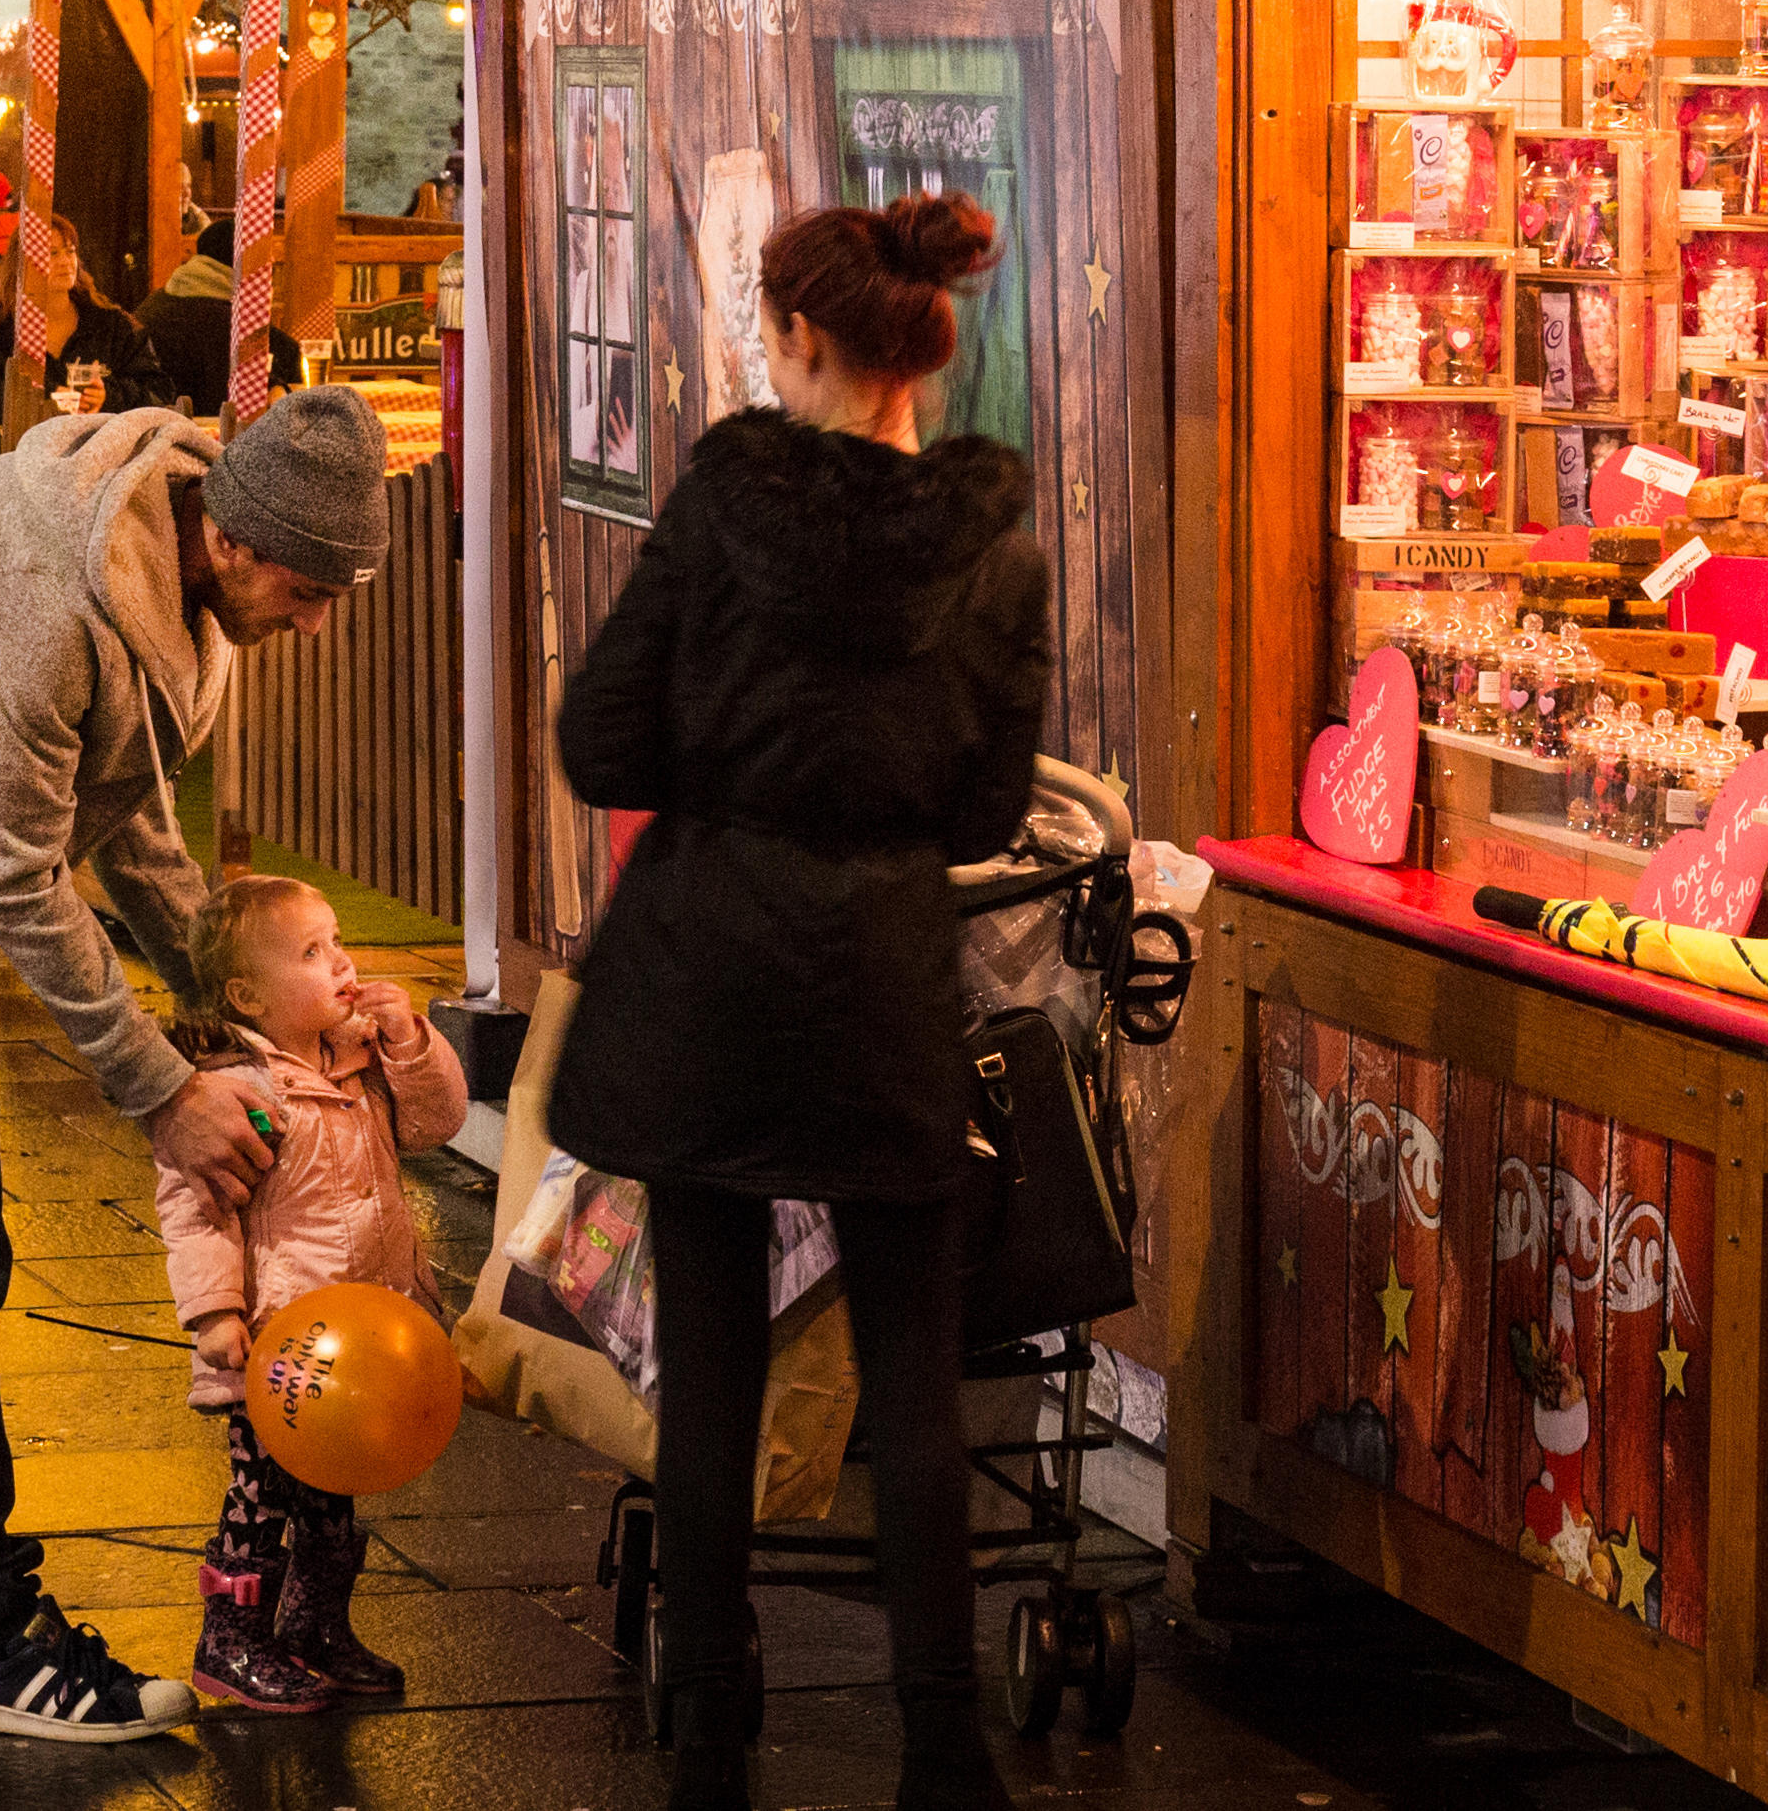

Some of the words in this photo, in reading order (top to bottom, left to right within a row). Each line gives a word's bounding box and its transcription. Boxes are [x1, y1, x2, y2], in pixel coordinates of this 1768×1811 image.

[1658, 567, 1681, 589] CHERRY
[1320, 683, 1386, 793] ASSORTMENT
[1331, 735, 1386, 825] FUDGE
[279, 1337, 295, 1354] is
[281, 1375, 302, 1430] way
